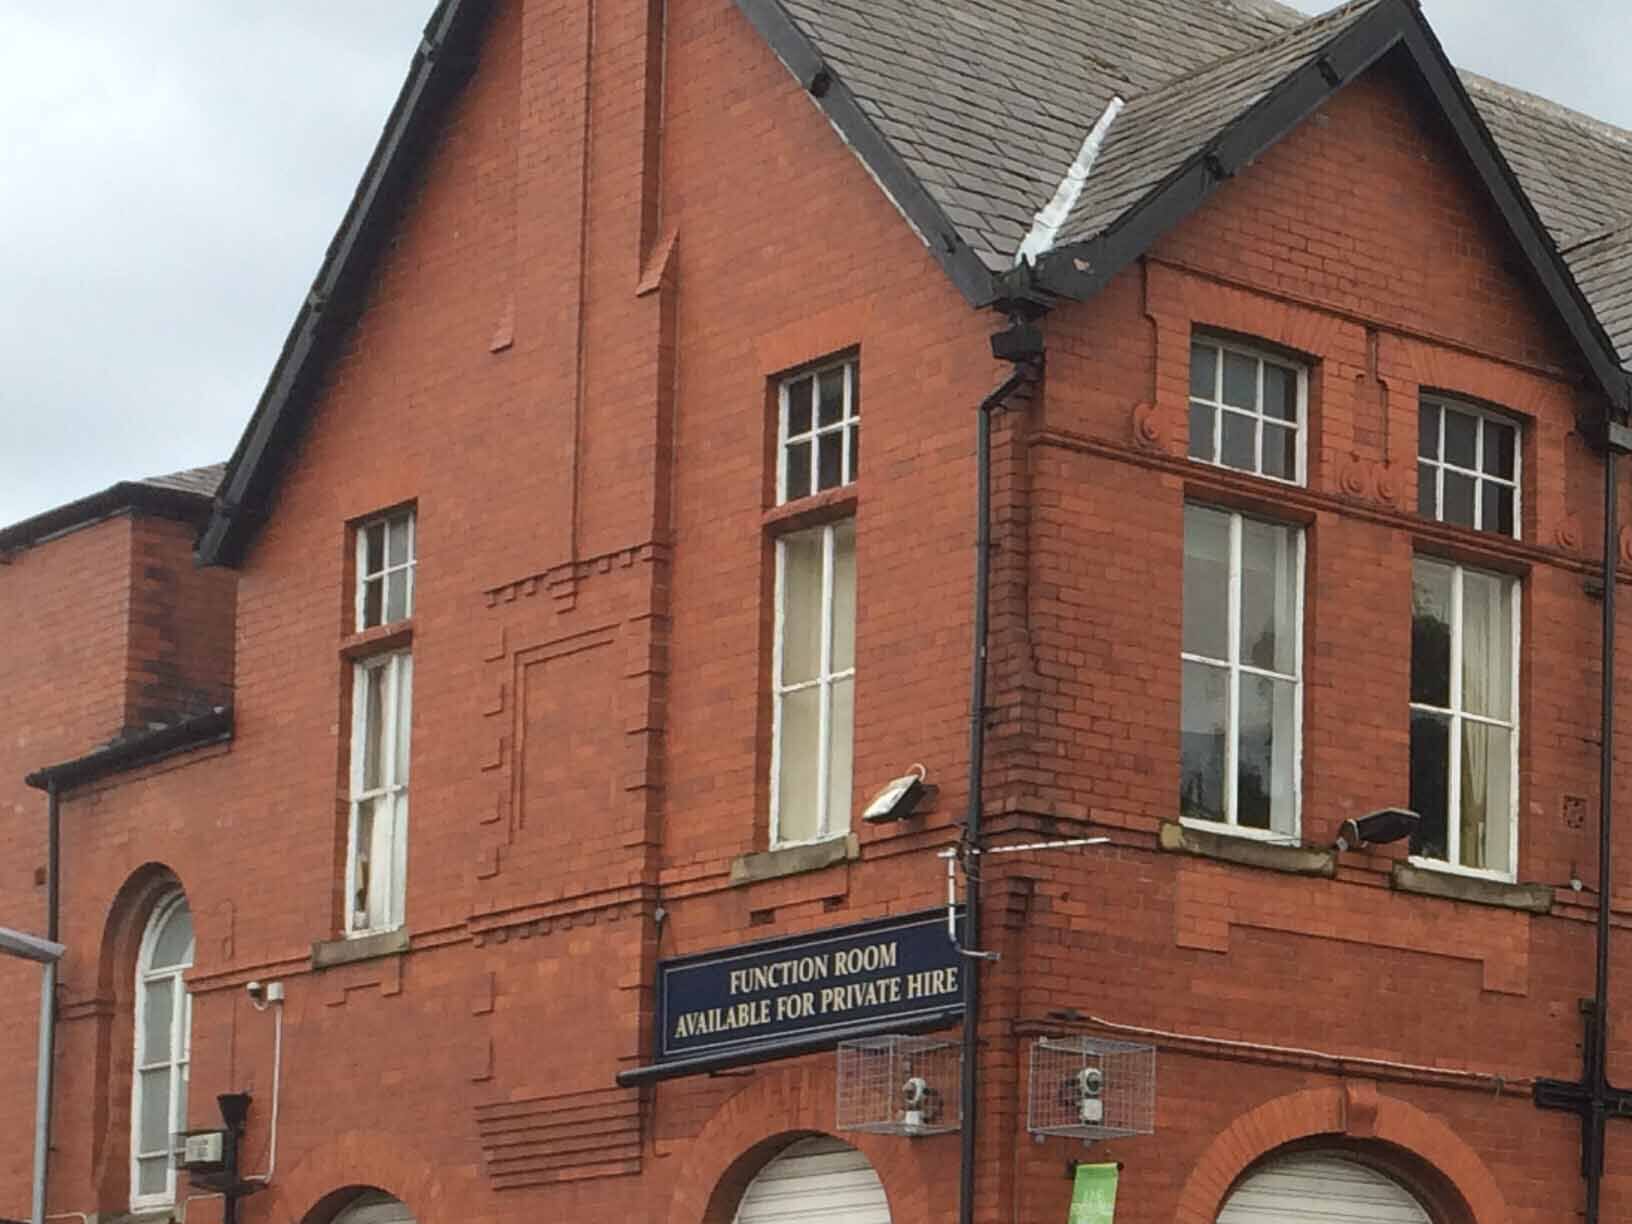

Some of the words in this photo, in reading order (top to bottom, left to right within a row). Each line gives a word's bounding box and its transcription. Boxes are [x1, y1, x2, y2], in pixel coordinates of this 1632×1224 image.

[729, 956, 828, 995] FUNCTION
[835, 942, 897, 975] ROOM
[675, 998, 771, 1038] AVAILABLE
[776, 991, 815, 1021] FOR
[821, 977, 901, 1013] PRIVATE
[907, 966, 958, 997] HIRE
